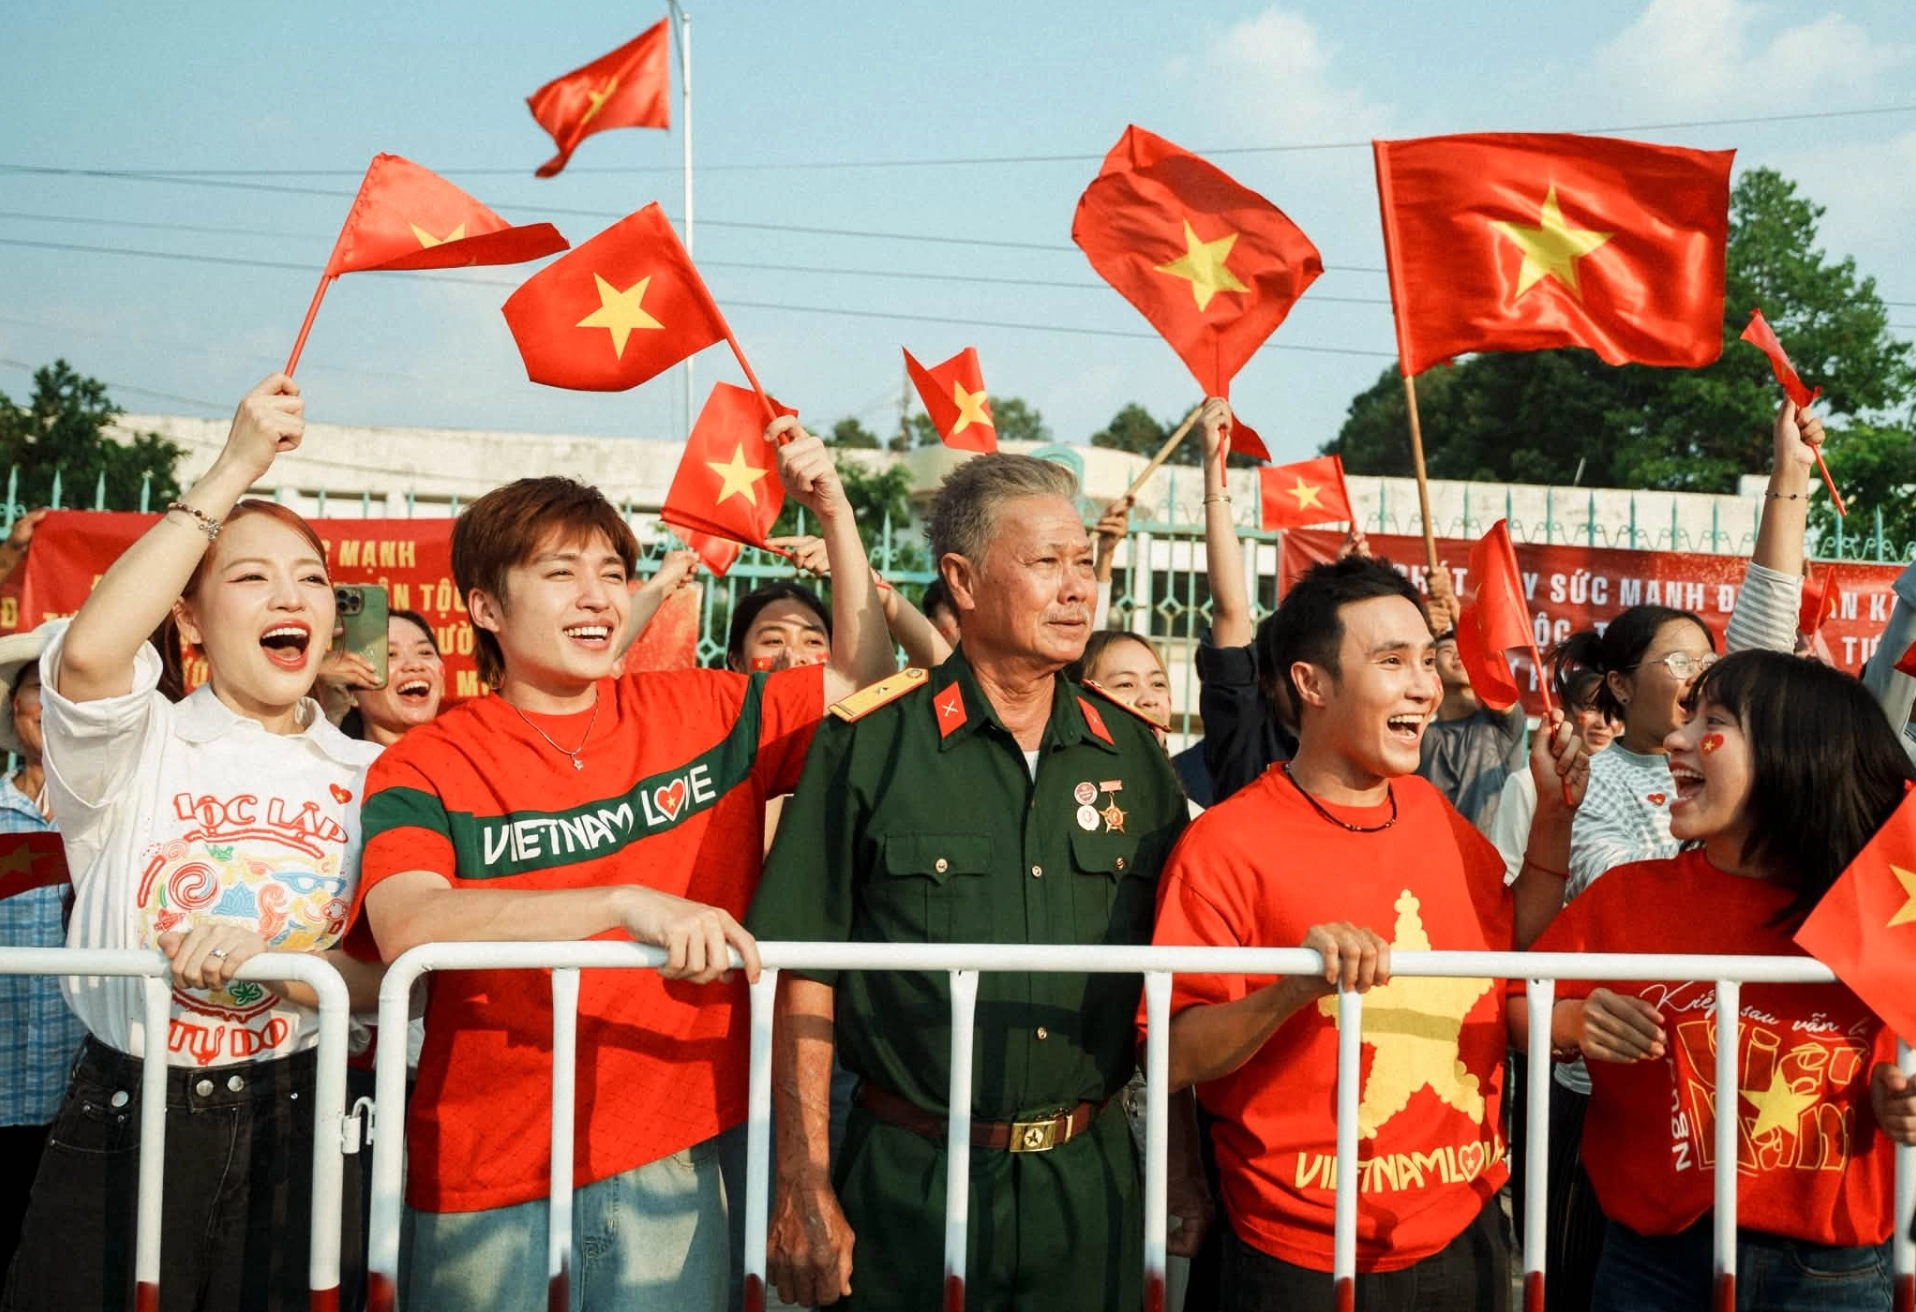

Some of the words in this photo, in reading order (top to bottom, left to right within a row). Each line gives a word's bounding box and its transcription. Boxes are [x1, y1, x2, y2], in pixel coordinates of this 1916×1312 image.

[338, 540, 416, 574] MẠNH
[1550, 568, 1608, 605] SỨC
[641, 764, 716, 828] LOVE
[1740, 1004, 1781, 1026] sau
[231, 1017, 288, 1057] DO
